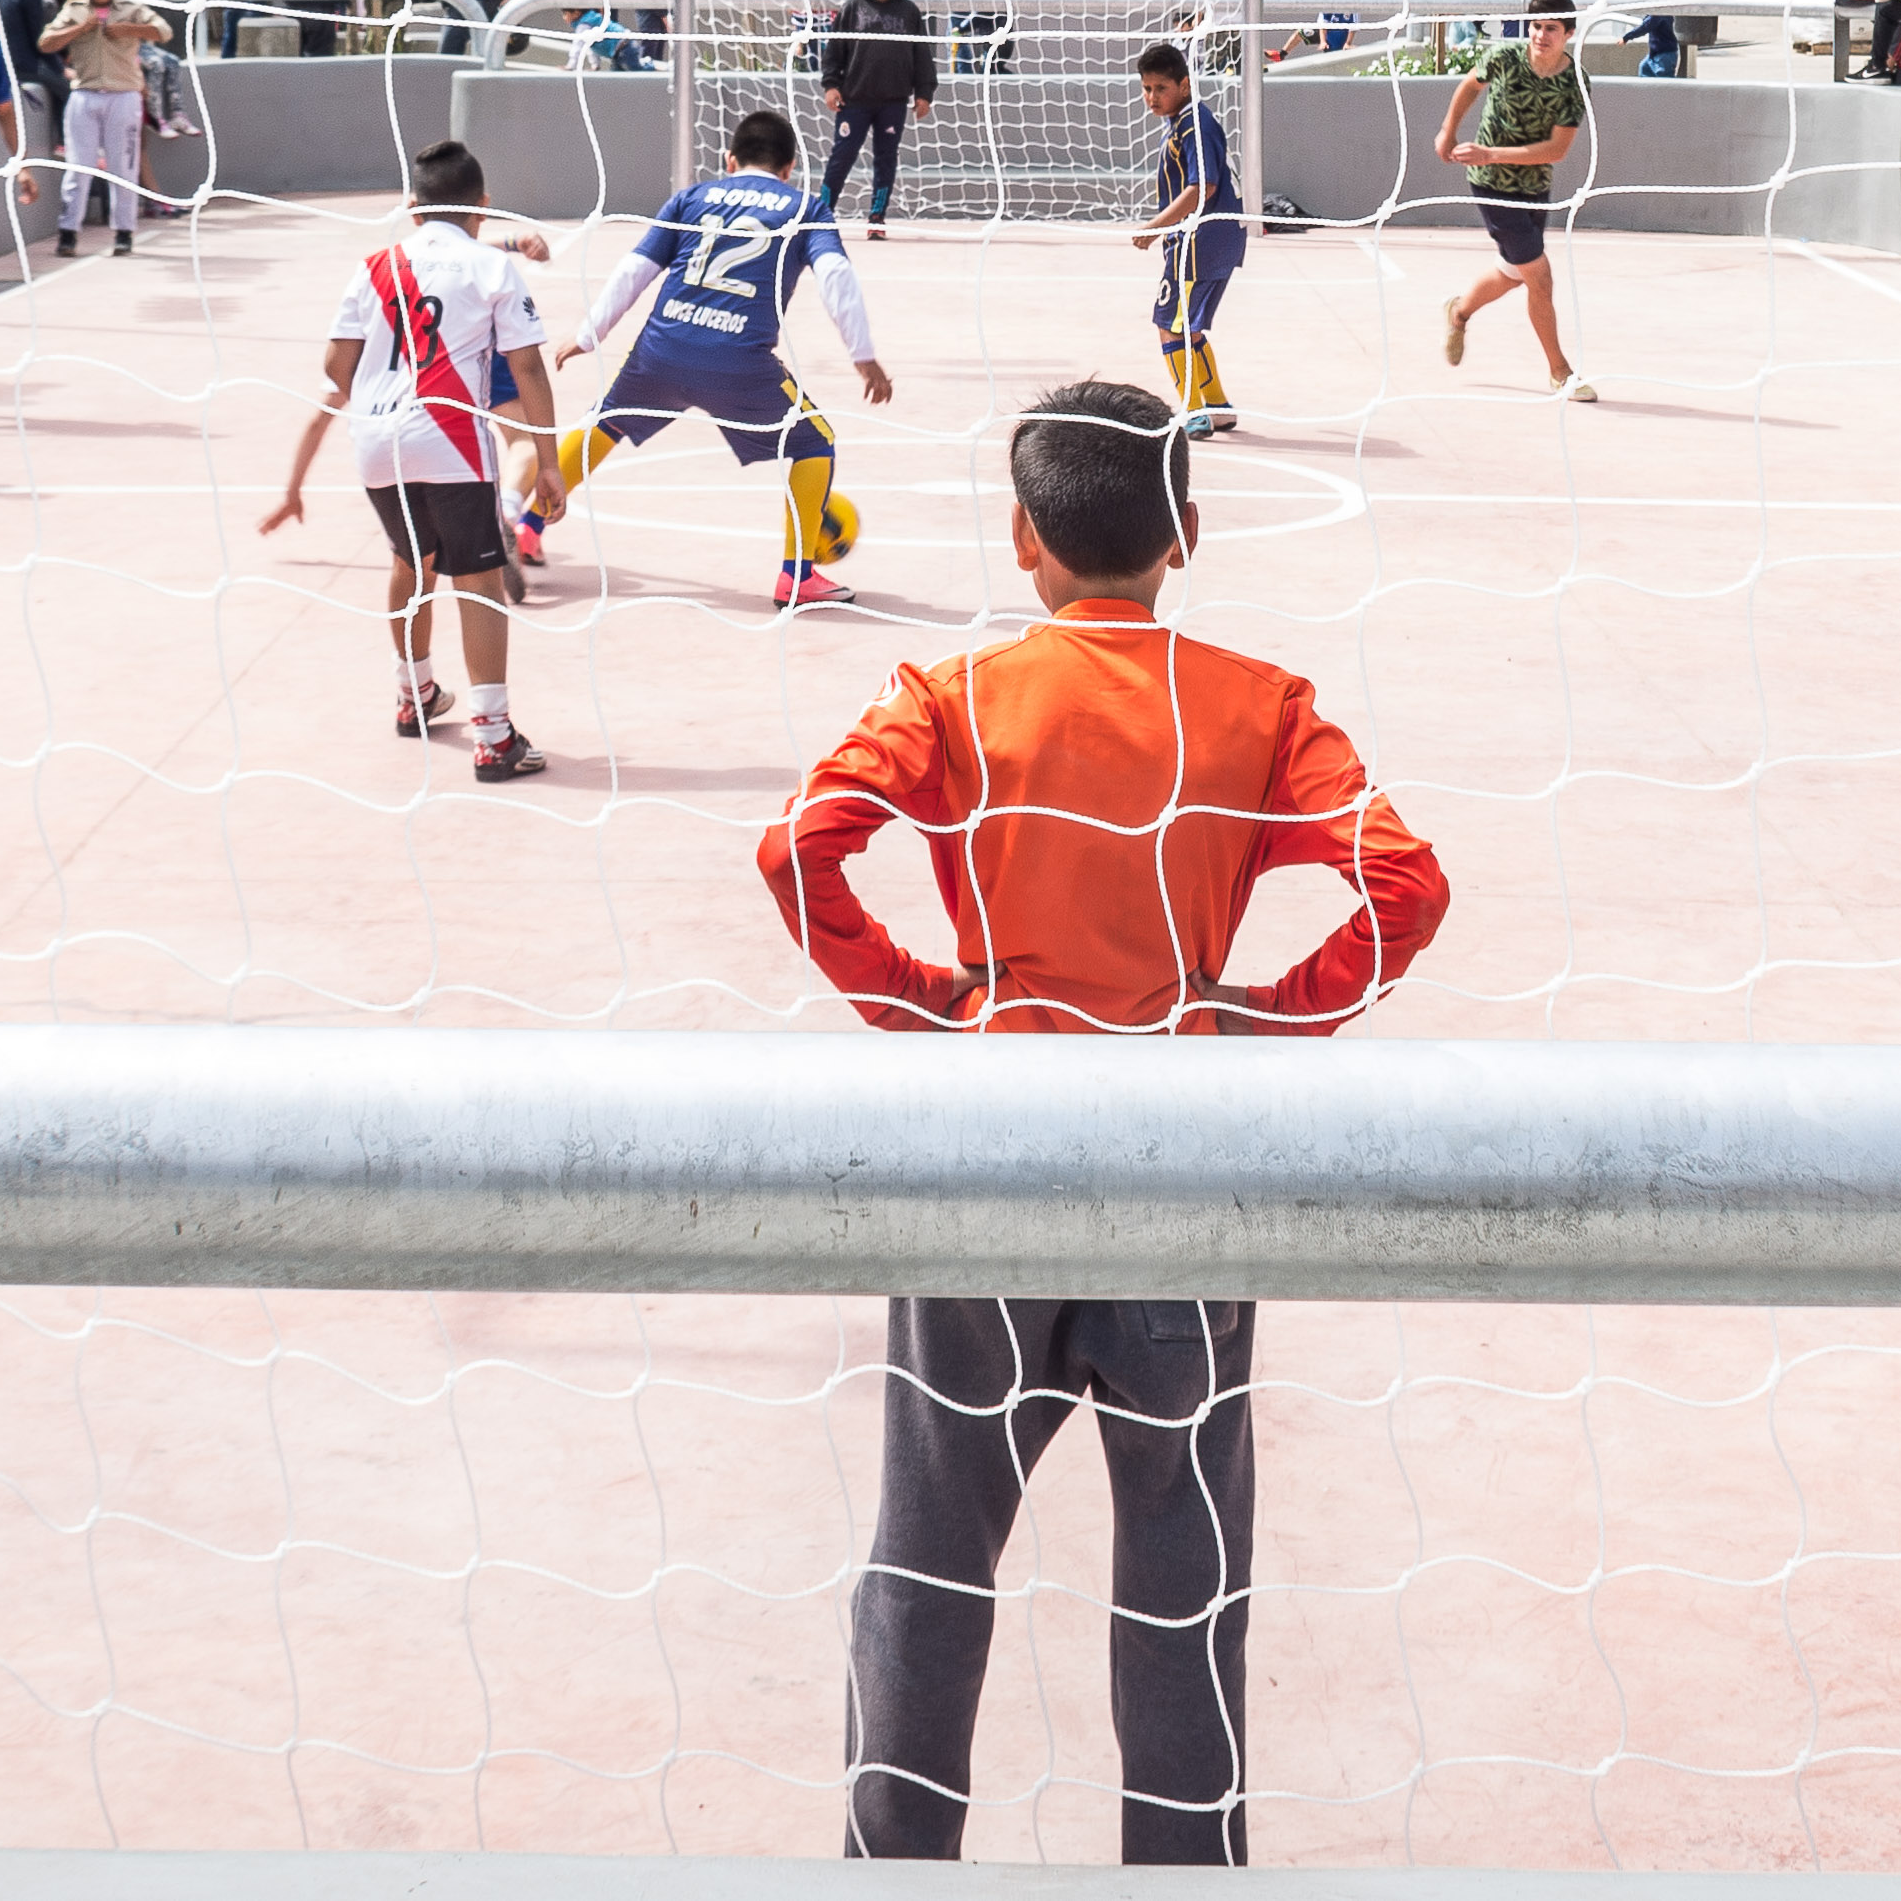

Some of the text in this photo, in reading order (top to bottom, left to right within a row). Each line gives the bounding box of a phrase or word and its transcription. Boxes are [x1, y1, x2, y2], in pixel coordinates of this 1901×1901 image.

[704, 187, 792, 212] RODRI
[683, 214, 772, 298] 12
[388, 294, 444, 372] 13
[662, 299, 749, 334] ONCE LUCEROS
